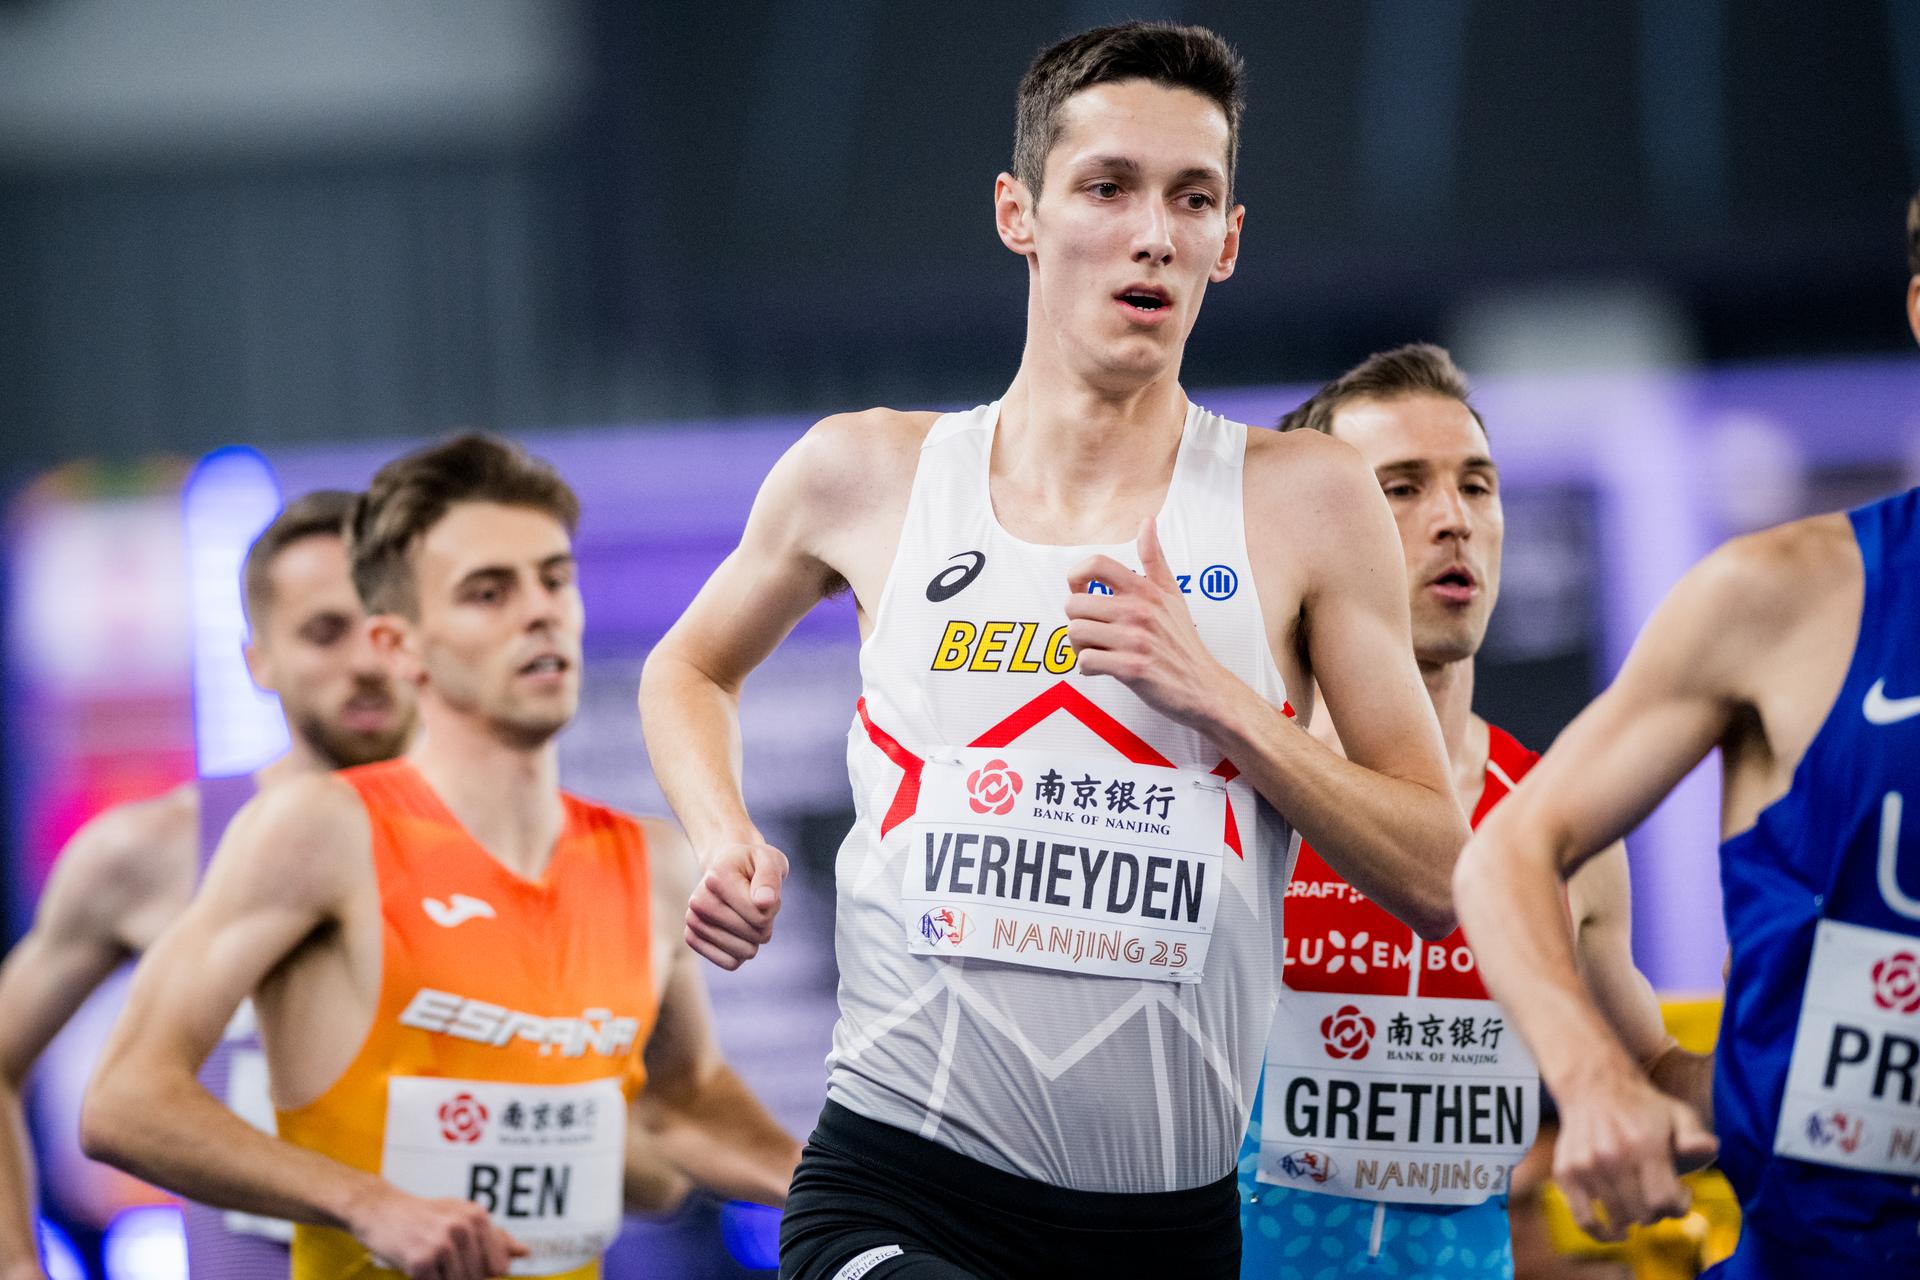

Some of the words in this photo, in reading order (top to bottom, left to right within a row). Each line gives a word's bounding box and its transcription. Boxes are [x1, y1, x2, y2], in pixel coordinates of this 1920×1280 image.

[931, 620, 1078, 675] BELG
[1033, 807, 1075, 823] BANK
[1081, 814, 1100, 826] OF
[1105, 817, 1171, 836] NANJING
[1035, 768, 1176, 821] 南京银行
[925, 832, 1206, 923] VERHEYDEN
[993, 918, 1145, 964] NANJING
[1150, 940, 1188, 969] 25
[400, 987, 640, 1057] ESPAÑA
[1387, 1011, 1503, 1049] 南京银行
[1387, 1050, 1424, 1061] BANK
[1429, 1052, 1445, 1062] OF
[1450, 1053, 1498, 1064] NANJING
[1823, 1022, 1920, 1106] PR
[1285, 1076, 1524, 1146] GRETHEN
[471, 1163, 570, 1219] BEN
[1355, 1159, 1489, 1195] NANJING
